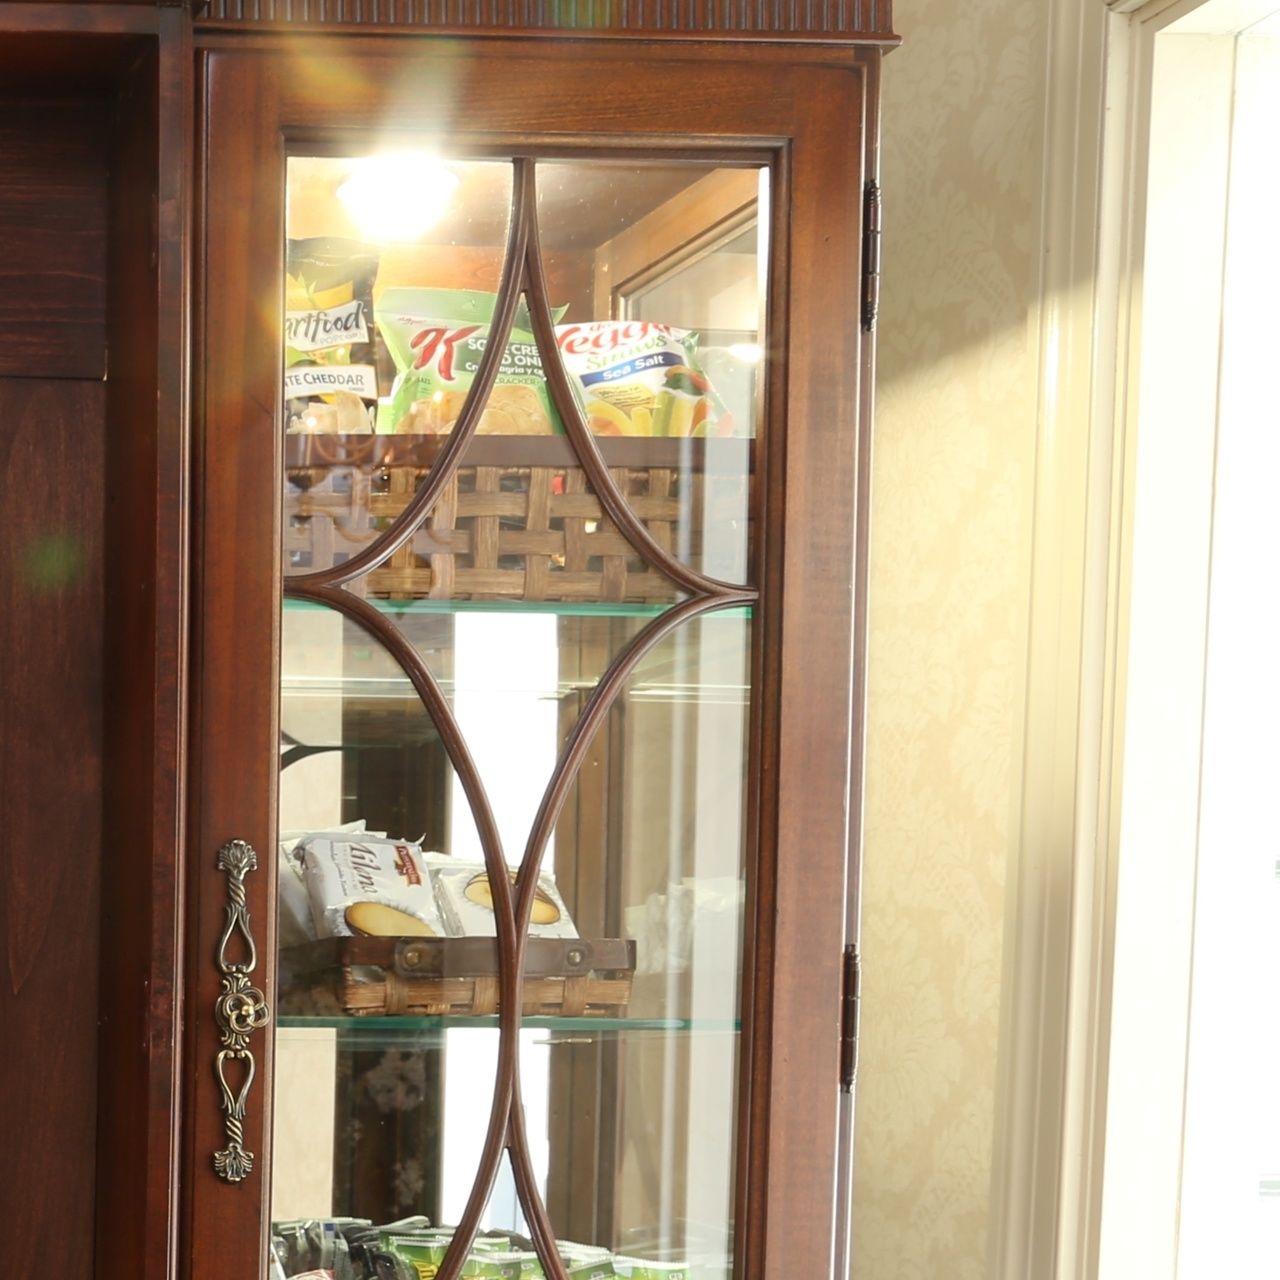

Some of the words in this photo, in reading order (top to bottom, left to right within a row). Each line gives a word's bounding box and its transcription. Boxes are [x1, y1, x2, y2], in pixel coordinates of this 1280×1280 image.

[604, 365, 632, 380] Sea
[635, 355, 664, 370] Salt
[303, 373, 365, 386] CHEDDAR
